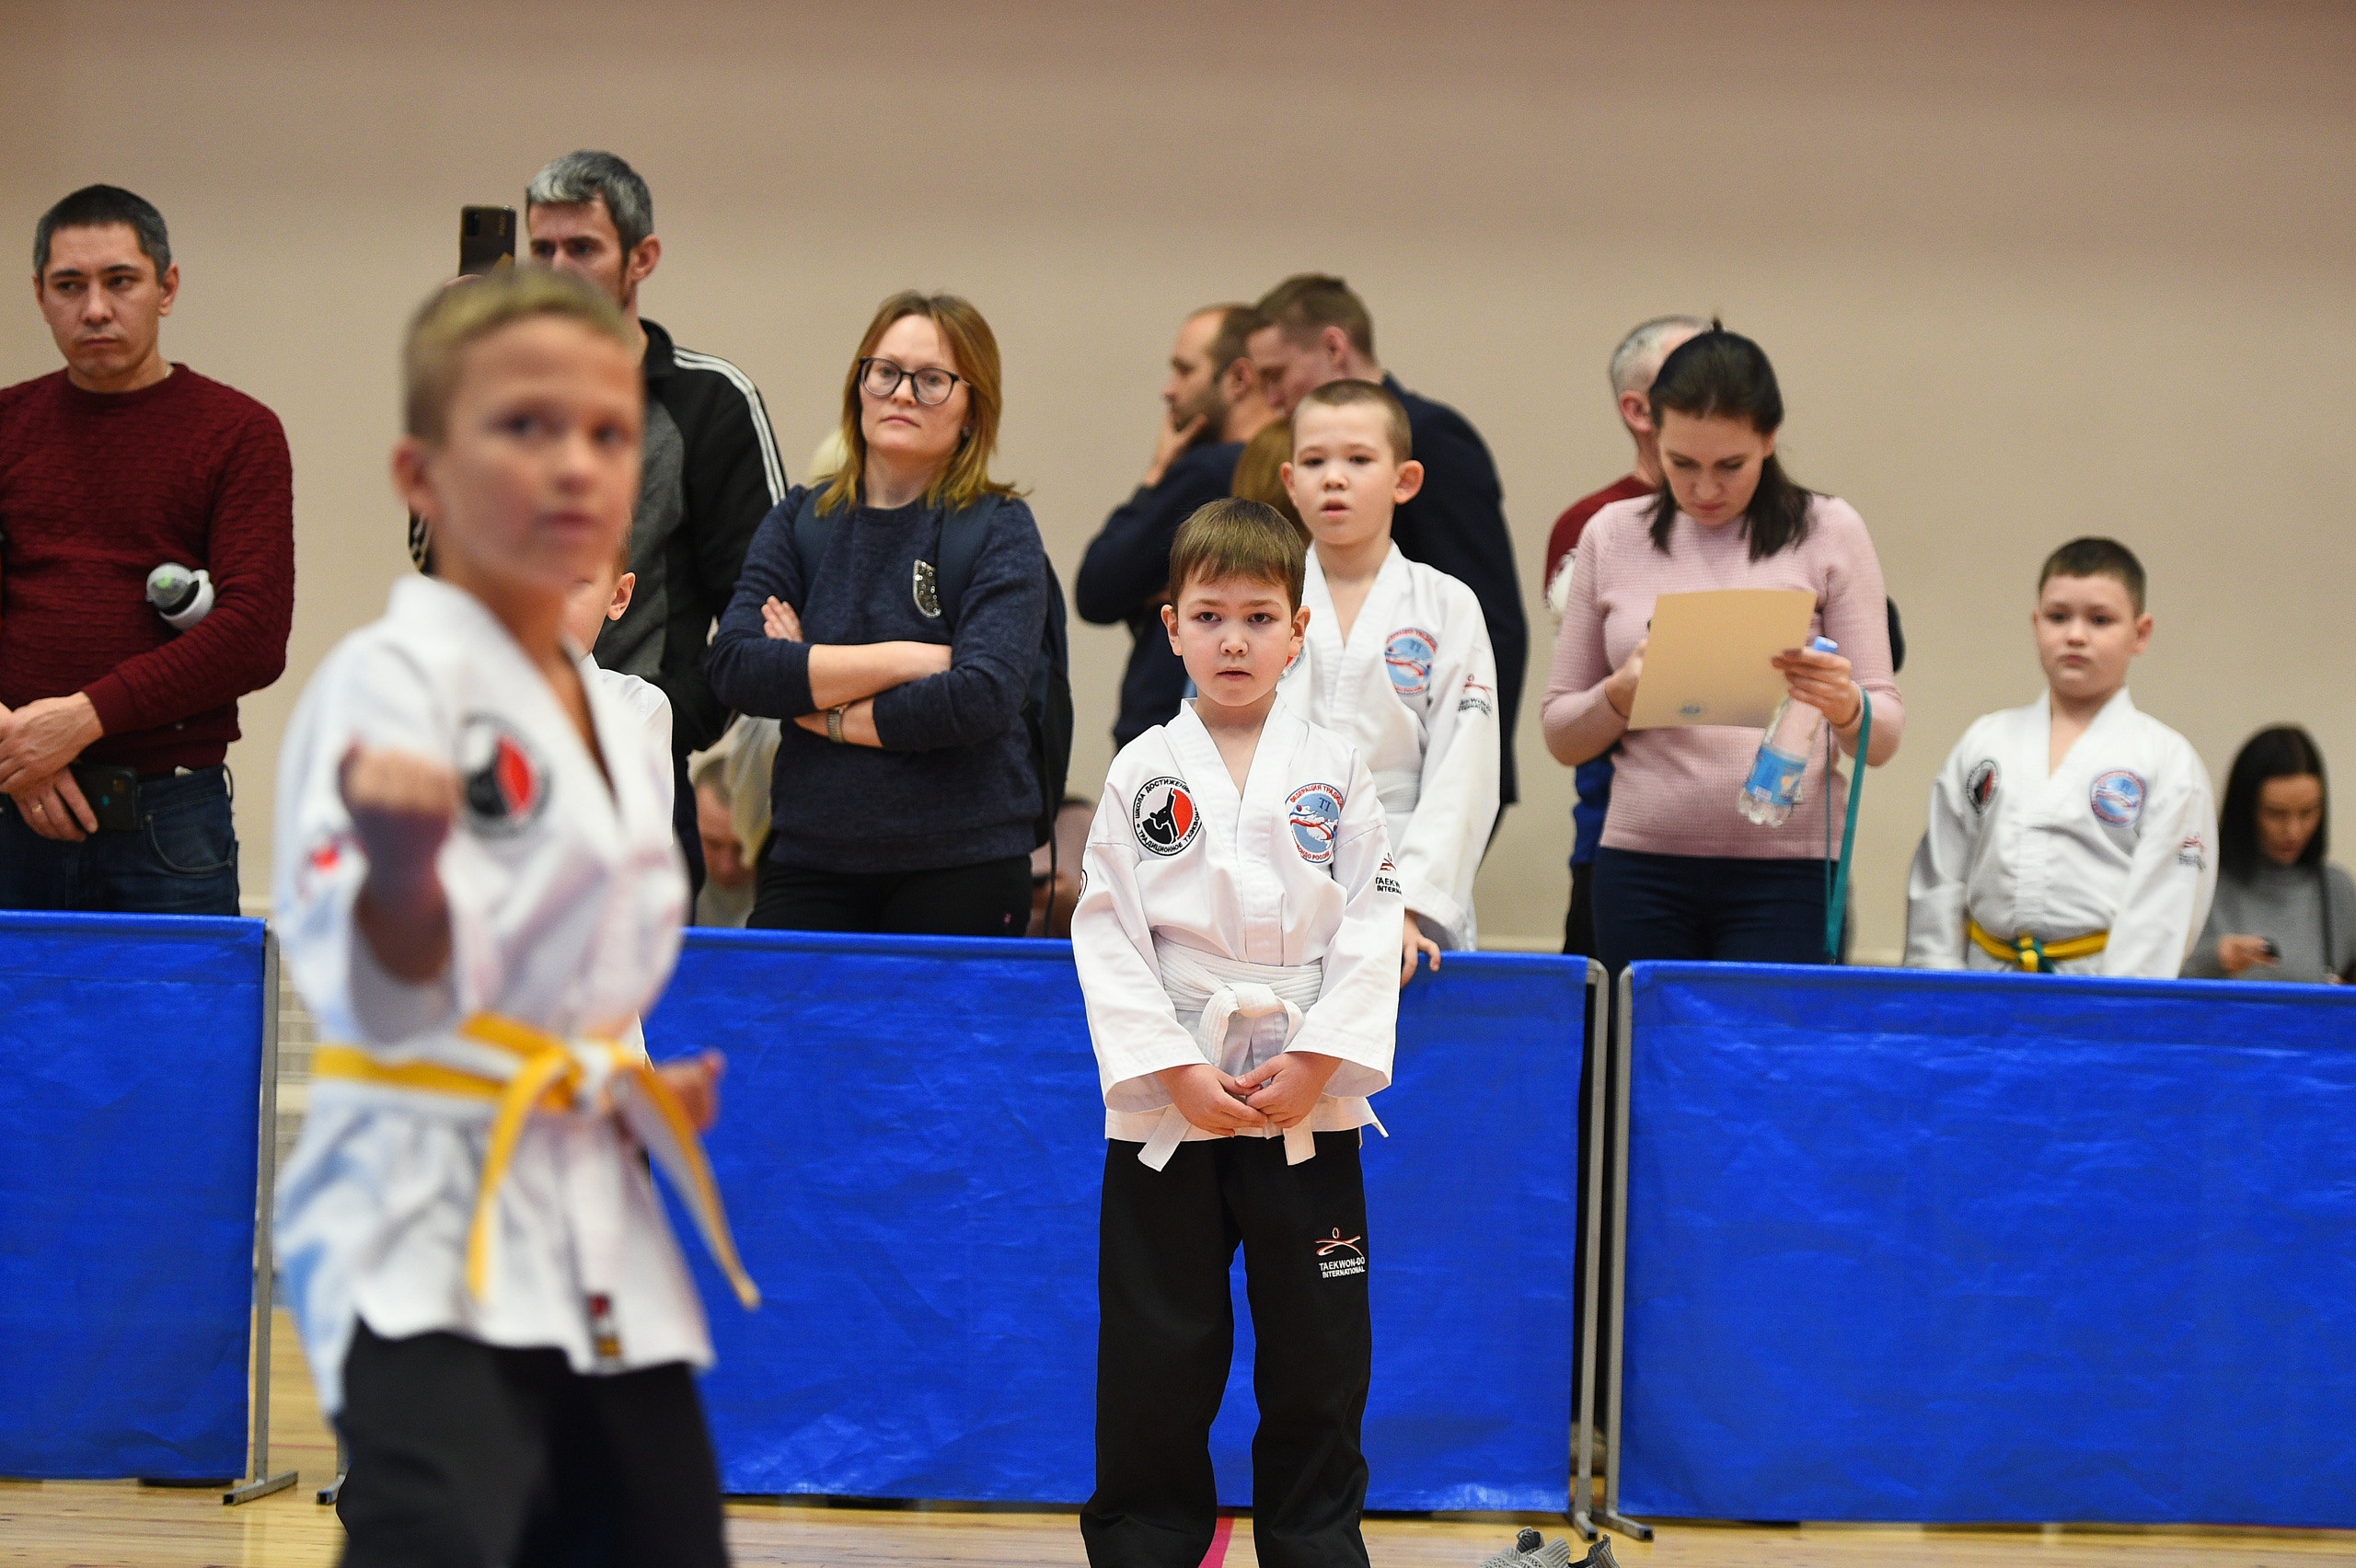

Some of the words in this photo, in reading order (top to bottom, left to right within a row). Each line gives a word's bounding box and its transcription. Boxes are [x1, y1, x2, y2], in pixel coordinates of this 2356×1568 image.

[1135, 793, 1146, 819] ШКОЛА
[1138, 829, 1184, 853] ТРАДИЦИОННОЕ
[1318, 1256, 1366, 1272] TAEKWON-DO
[1322, 1265, 1366, 1279] INTERNATIONAL
